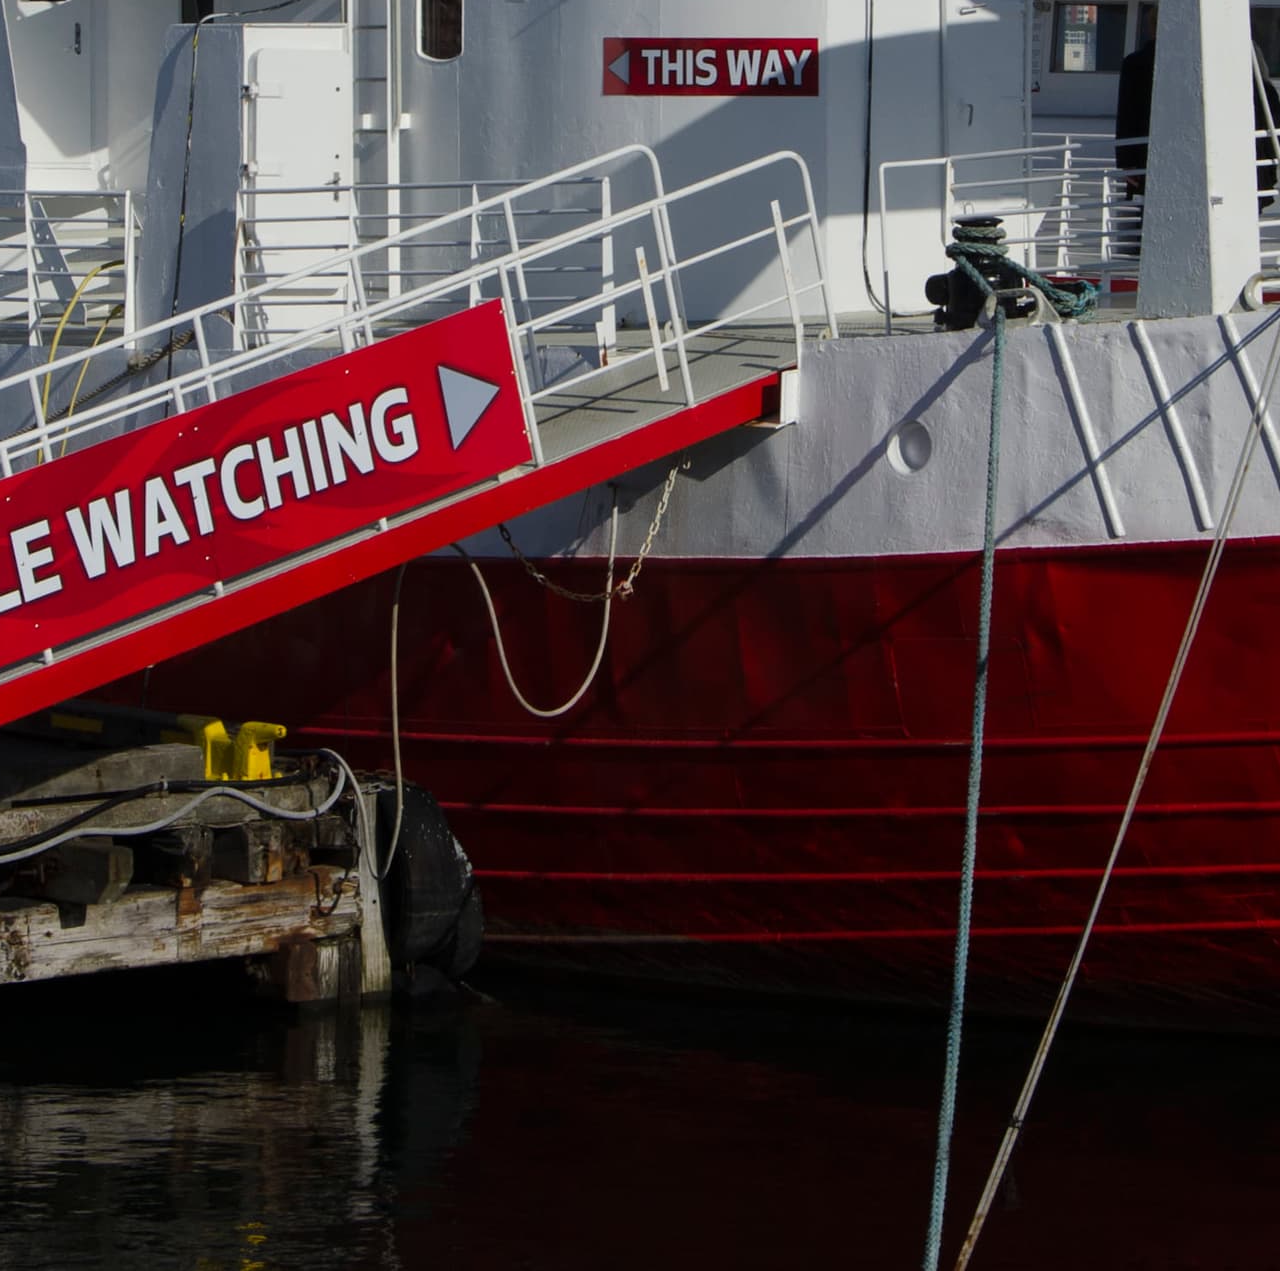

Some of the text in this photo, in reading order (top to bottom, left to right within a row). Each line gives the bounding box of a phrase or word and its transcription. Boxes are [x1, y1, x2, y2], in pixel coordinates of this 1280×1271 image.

[641, 49, 812, 86] THIS WAY
[65, 387, 419, 579] WATCHING
